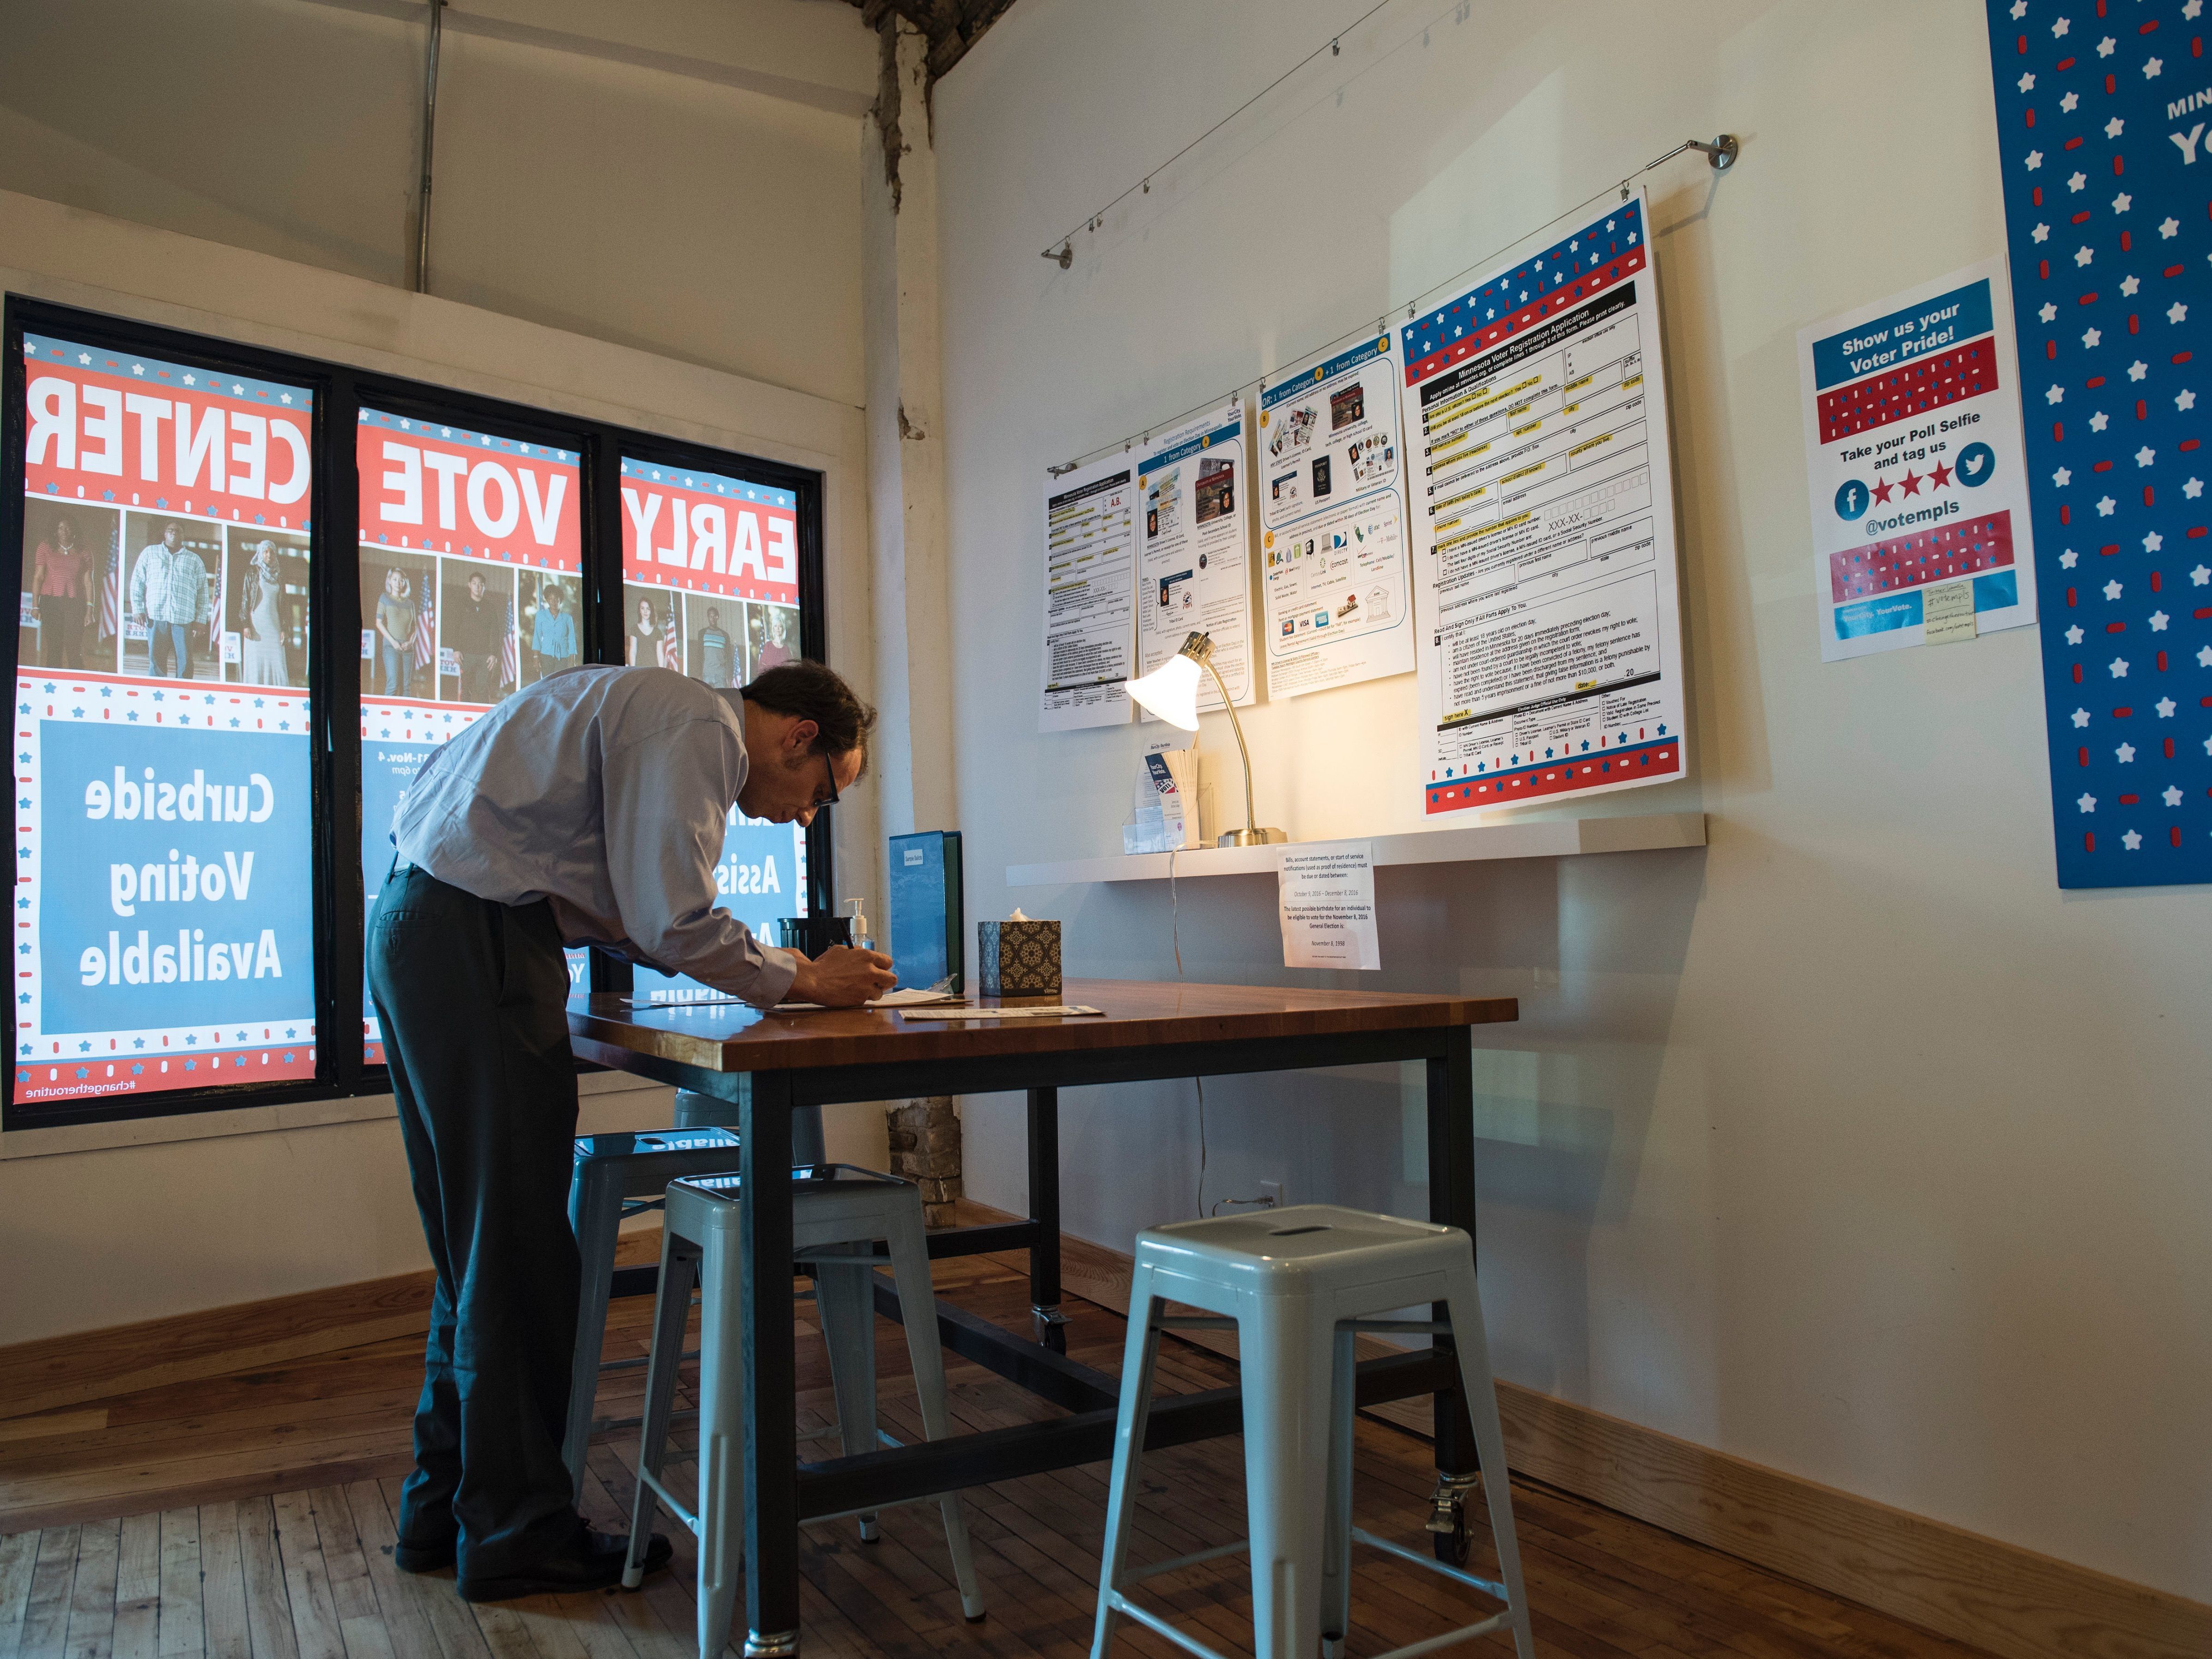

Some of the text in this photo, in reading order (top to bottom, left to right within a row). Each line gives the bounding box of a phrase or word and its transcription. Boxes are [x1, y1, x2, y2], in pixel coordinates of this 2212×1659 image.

[1842, 304, 1959, 355] Show us your
[1429, 391, 1441, 400] Apply
[1442, 385, 1455, 394] online
[1460, 370, 1487, 386] mnvotes.org,
[1493, 357, 1513, 370] complete
[1514, 351, 1524, 360] lines
[1528, 341, 1546, 352] through
[1566, 325, 1578, 334] form.
[1579, 316, 1594, 328] Please
[1595, 309, 1607, 321] print
[1608, 301, 1625, 313] clearly.
[1458, 310, 1589, 379] Minnesota Voter Registration Application
[1850, 325, 1953, 374] Voter Pride!
[1336, 360, 1350, 371] from
[1351, 347, 1377, 364] Category
[1262, 396, 1272, 407] OR:
[1279, 388, 1291, 398] from
[1292, 377, 1314, 392] Category
[1422, 402, 1439, 413] Personal
[1440, 391, 1463, 406] Information
[1468, 376, 1496, 392] Qualifications
[1163, 421, 1211, 445] Registration Requirements
[1840, 413, 1980, 462] Take your Poll Selfie
[1168, 452, 1180, 461] from
[1180, 443, 1201, 456] Category
[1874, 442, 1946, 470] and tag us
[1110, 497, 1121, 507] A.B.
[1866, 501, 1959, 536] @votempls
[1433, 571, 1475, 589] Registration Updates
[1498, 608, 1510, 616] Apply
[1843, 612, 1874, 622] YourCity.
[1876, 604, 1912, 615] YourVote.
[1160, 783, 1171, 793] VOTE
